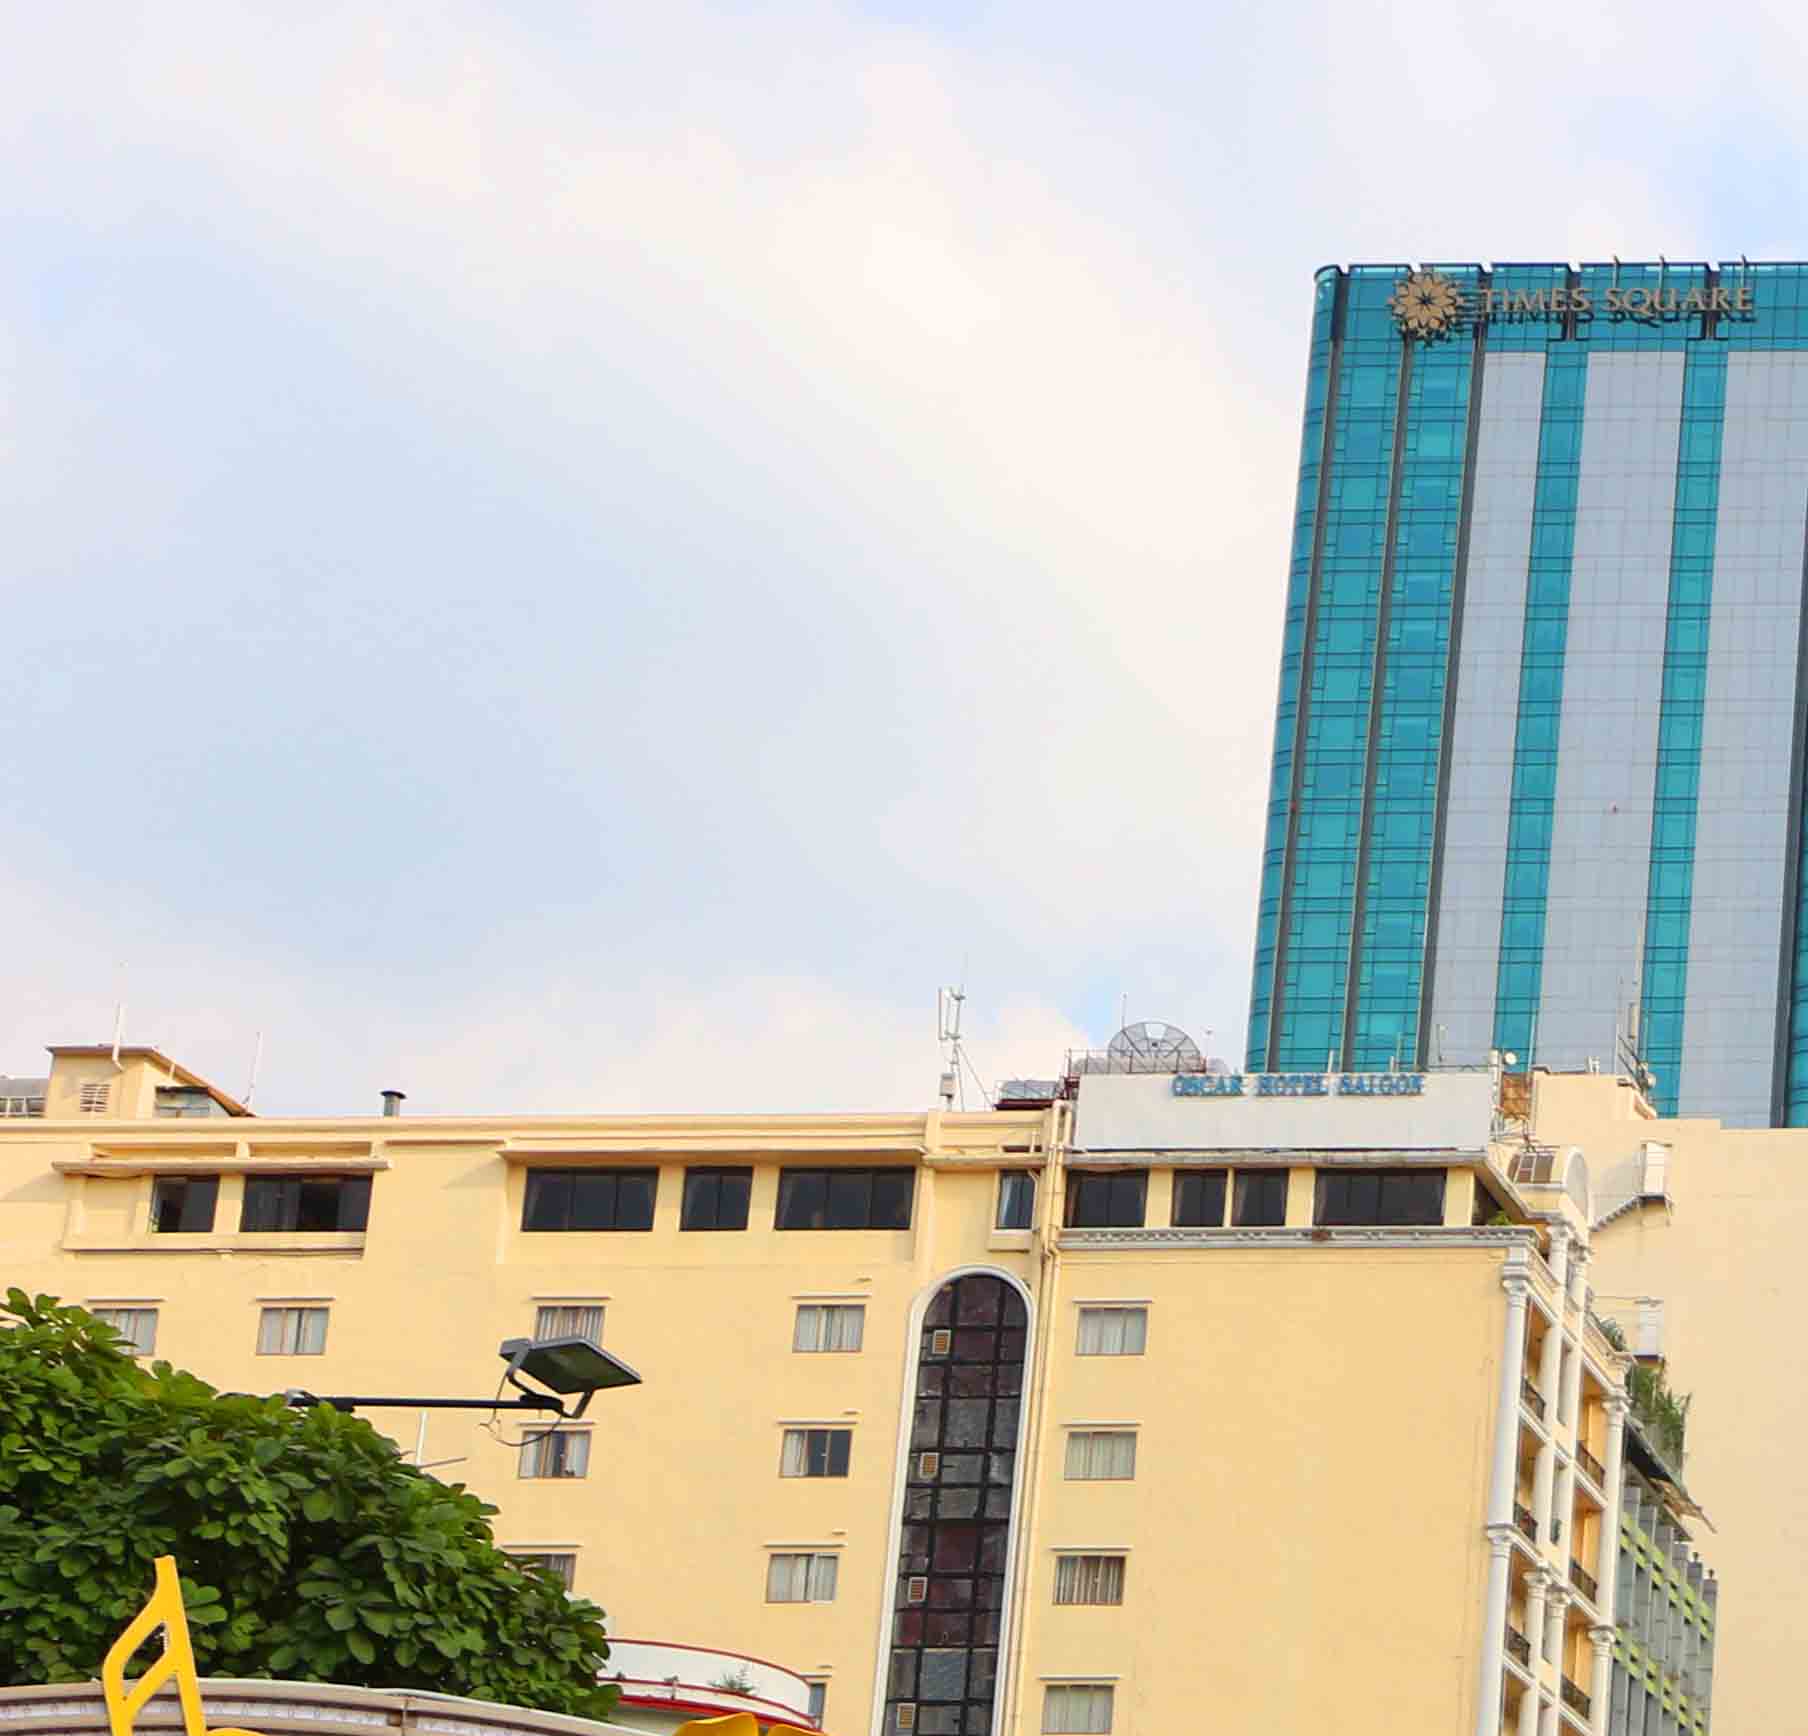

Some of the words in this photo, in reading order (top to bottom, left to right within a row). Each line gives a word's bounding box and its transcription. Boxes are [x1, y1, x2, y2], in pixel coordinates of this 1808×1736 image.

[1481, 287, 1590, 313] TIMES
[1603, 287, 1754, 315] SQUARE
[1171, 1074, 1246, 1096] OSCAR
[1255, 1073, 1329, 1096] HOTEL
[1337, 1073, 1425, 1096] SAIGON
